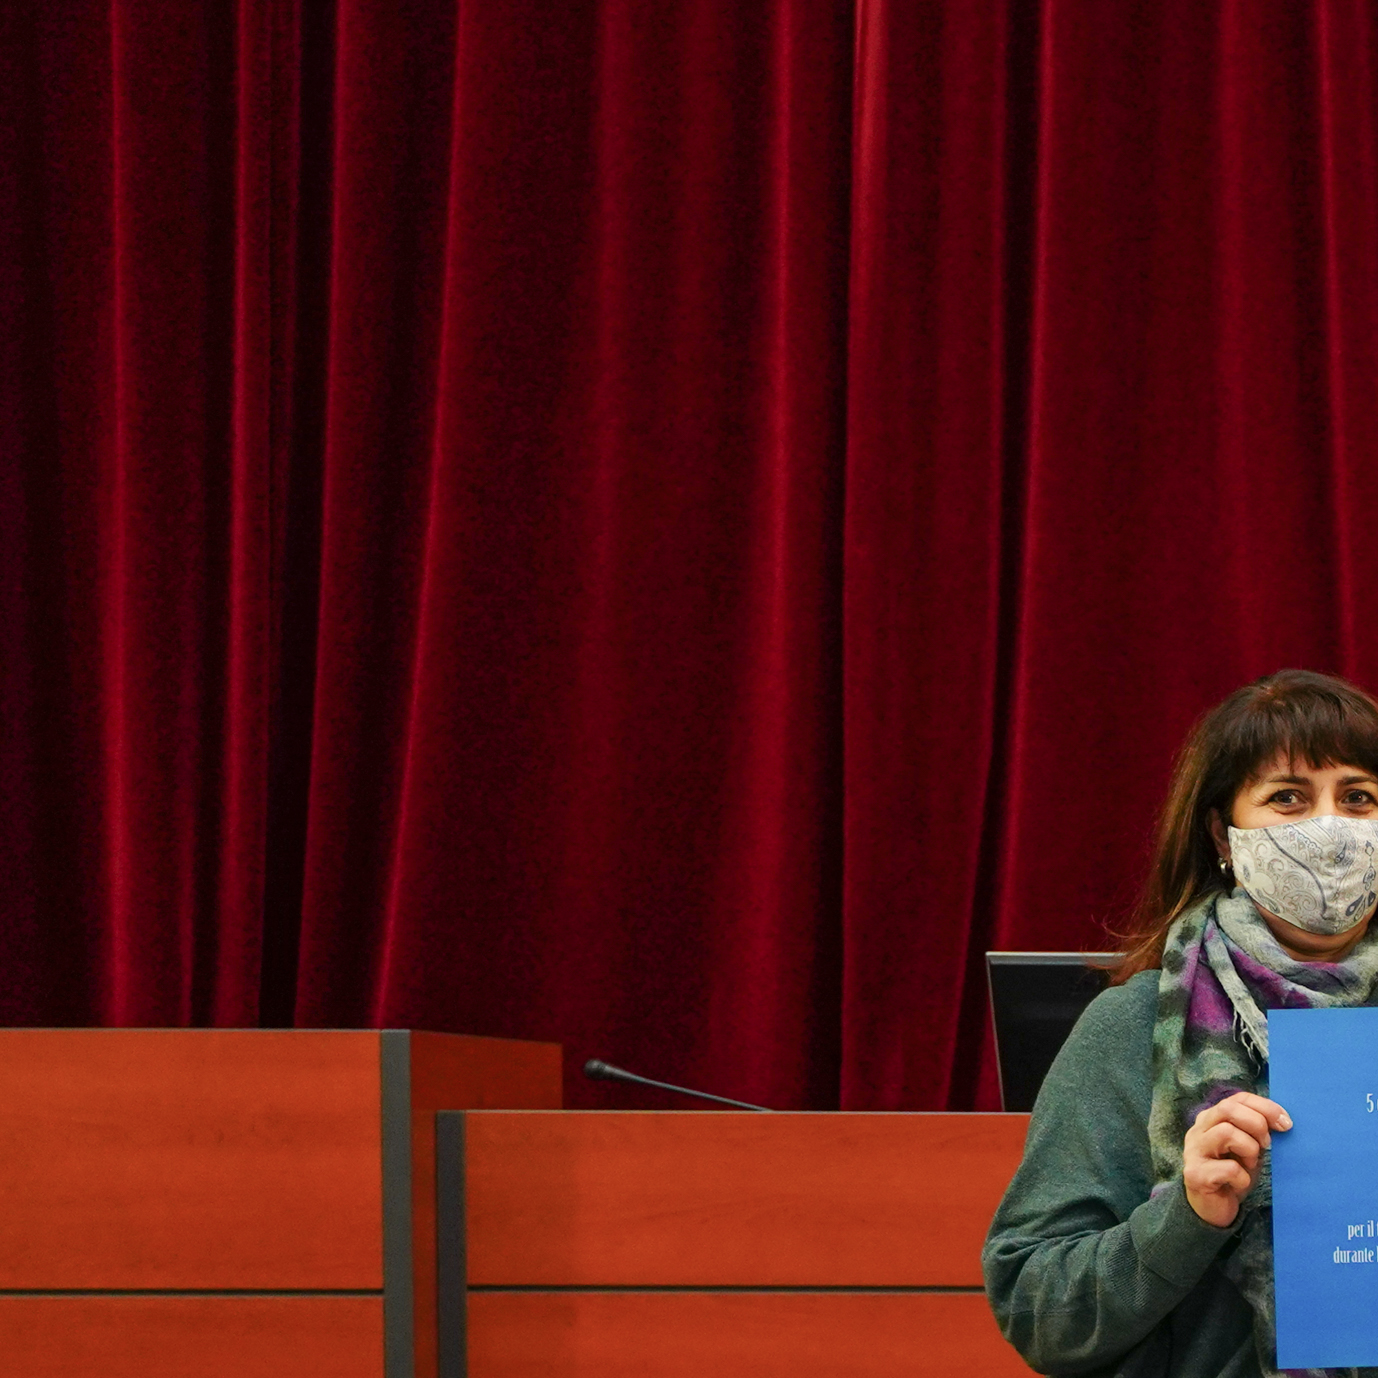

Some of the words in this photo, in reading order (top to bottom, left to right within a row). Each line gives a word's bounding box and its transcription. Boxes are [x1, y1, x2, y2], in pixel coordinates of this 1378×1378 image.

[1366, 1093, 1375, 1113] 5
[1347, 1224, 1365, 1241] per
[1366, 1219, 1375, 1238] il
[1333, 1246, 1375, 1264] durante
